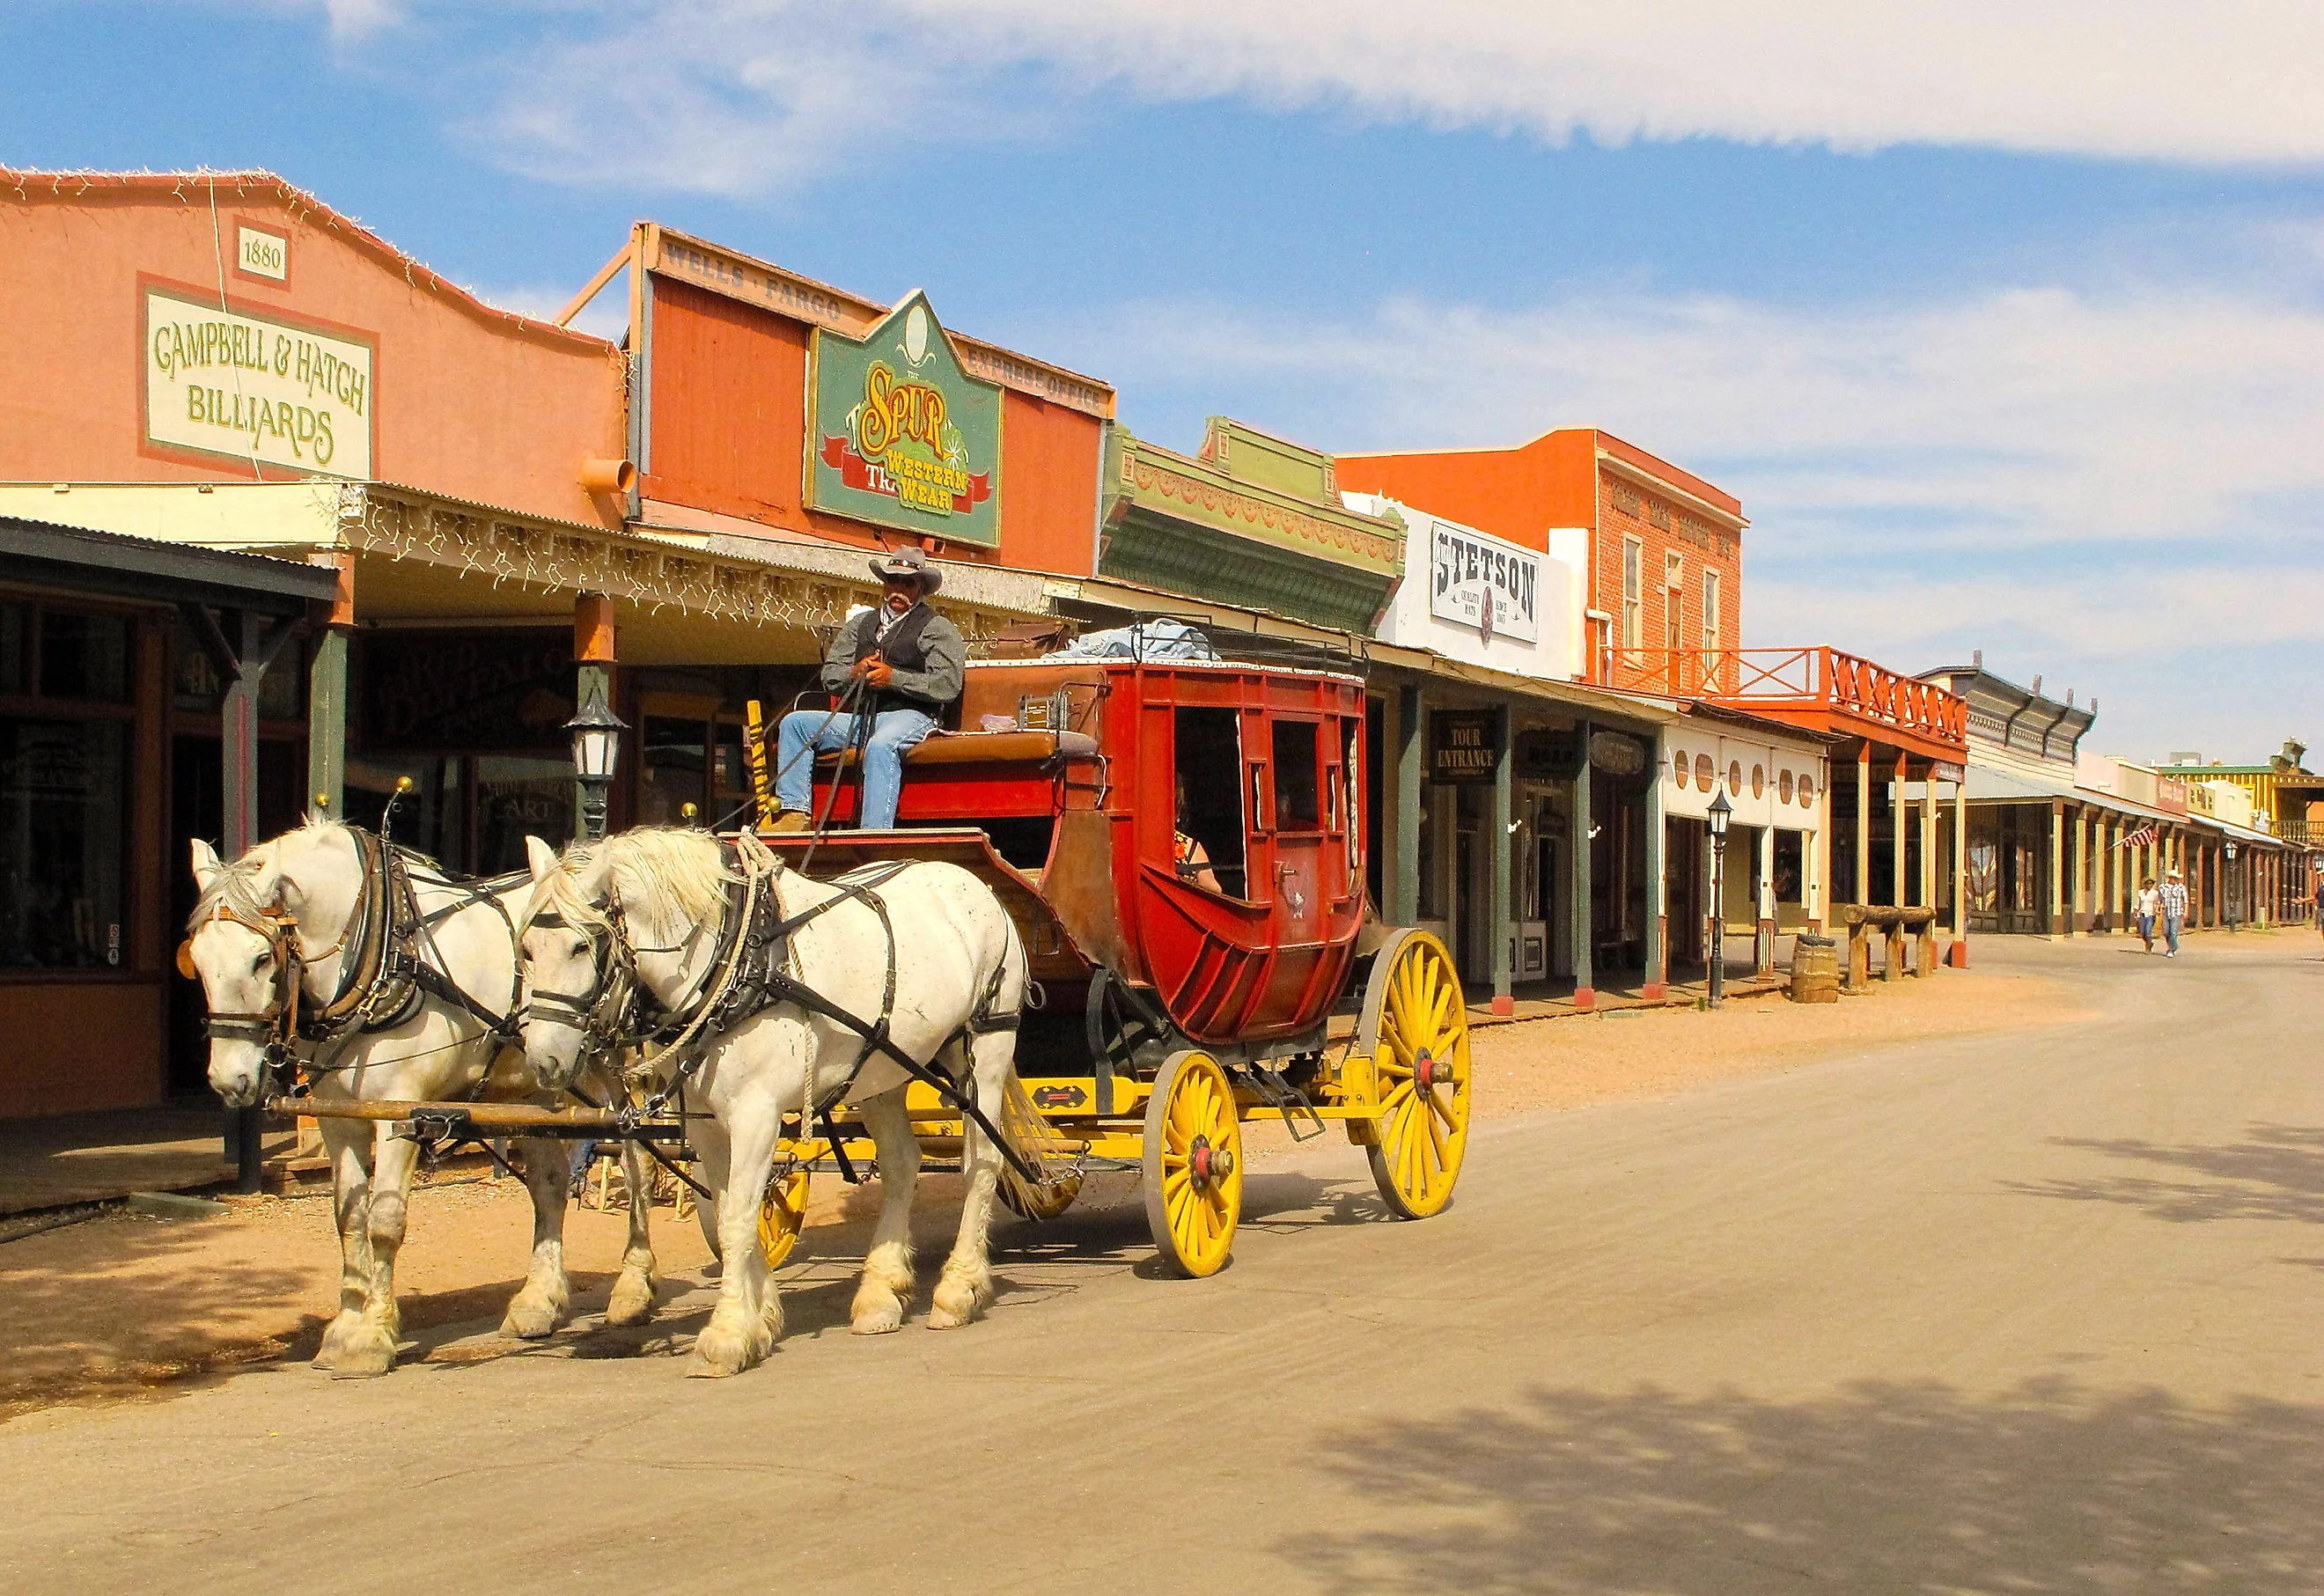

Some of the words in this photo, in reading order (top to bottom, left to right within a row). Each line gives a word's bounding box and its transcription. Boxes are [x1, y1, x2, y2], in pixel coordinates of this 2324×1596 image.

[245, 239, 281, 268] 1880
[666, 242, 744, 289] WELLS
[766, 277, 842, 320] FARGO
[155, 321, 268, 381] CAMPBELL
[274, 334, 291, 379] &
[297, 339, 365, 416] HATCH
[968, 348, 1044, 388] EXPRESS
[1048, 375, 1101, 407] OFFICE
[187, 385, 335, 467] BILLIARDS
[886, 449, 967, 491] WESTERN
[900, 477, 952, 511] WEAR
[1437, 533, 1535, 624] STETSON
[1437, 749, 1494, 768] ENTRANCE
[1451, 728, 1481, 747] TOUR
